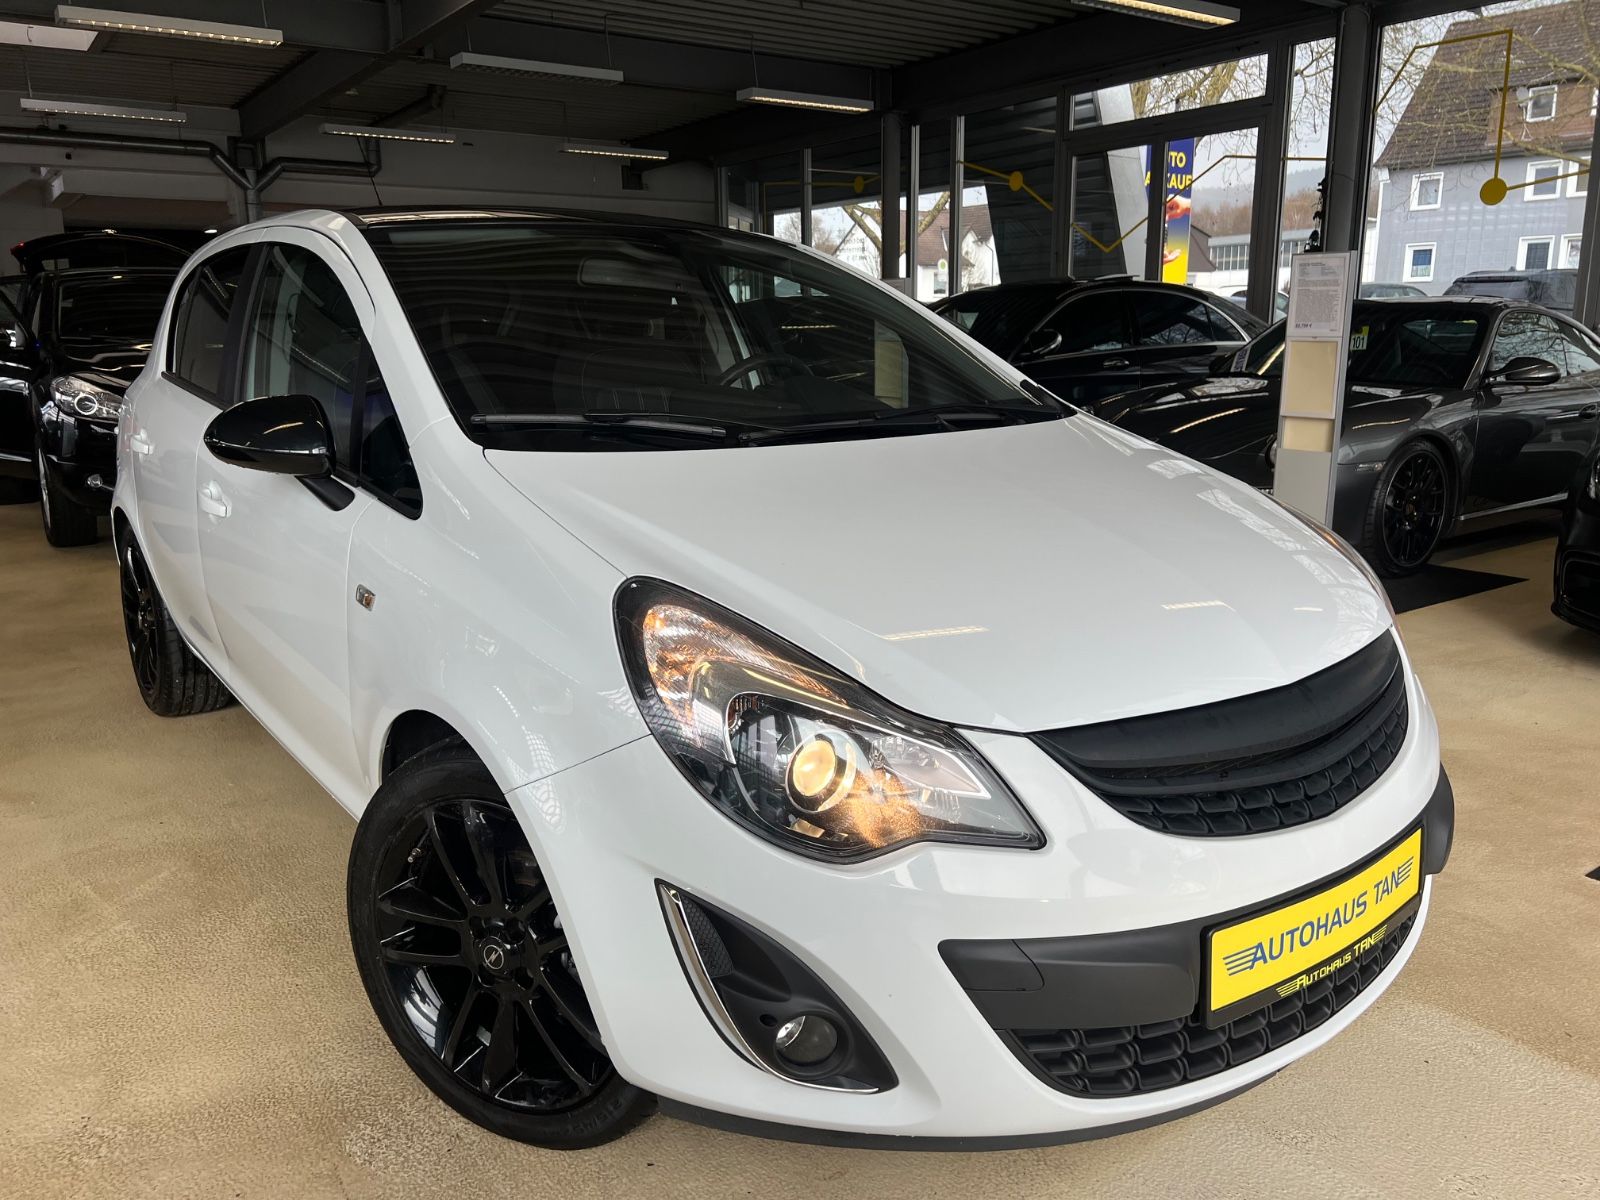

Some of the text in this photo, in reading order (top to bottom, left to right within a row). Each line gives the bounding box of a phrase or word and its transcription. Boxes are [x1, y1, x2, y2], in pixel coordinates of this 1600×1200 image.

[1168, 151, 1187, 168] TO
[1249, 865, 1402, 970] AUTOHAUS TAN
[1353, 935, 1376, 957] TAN
